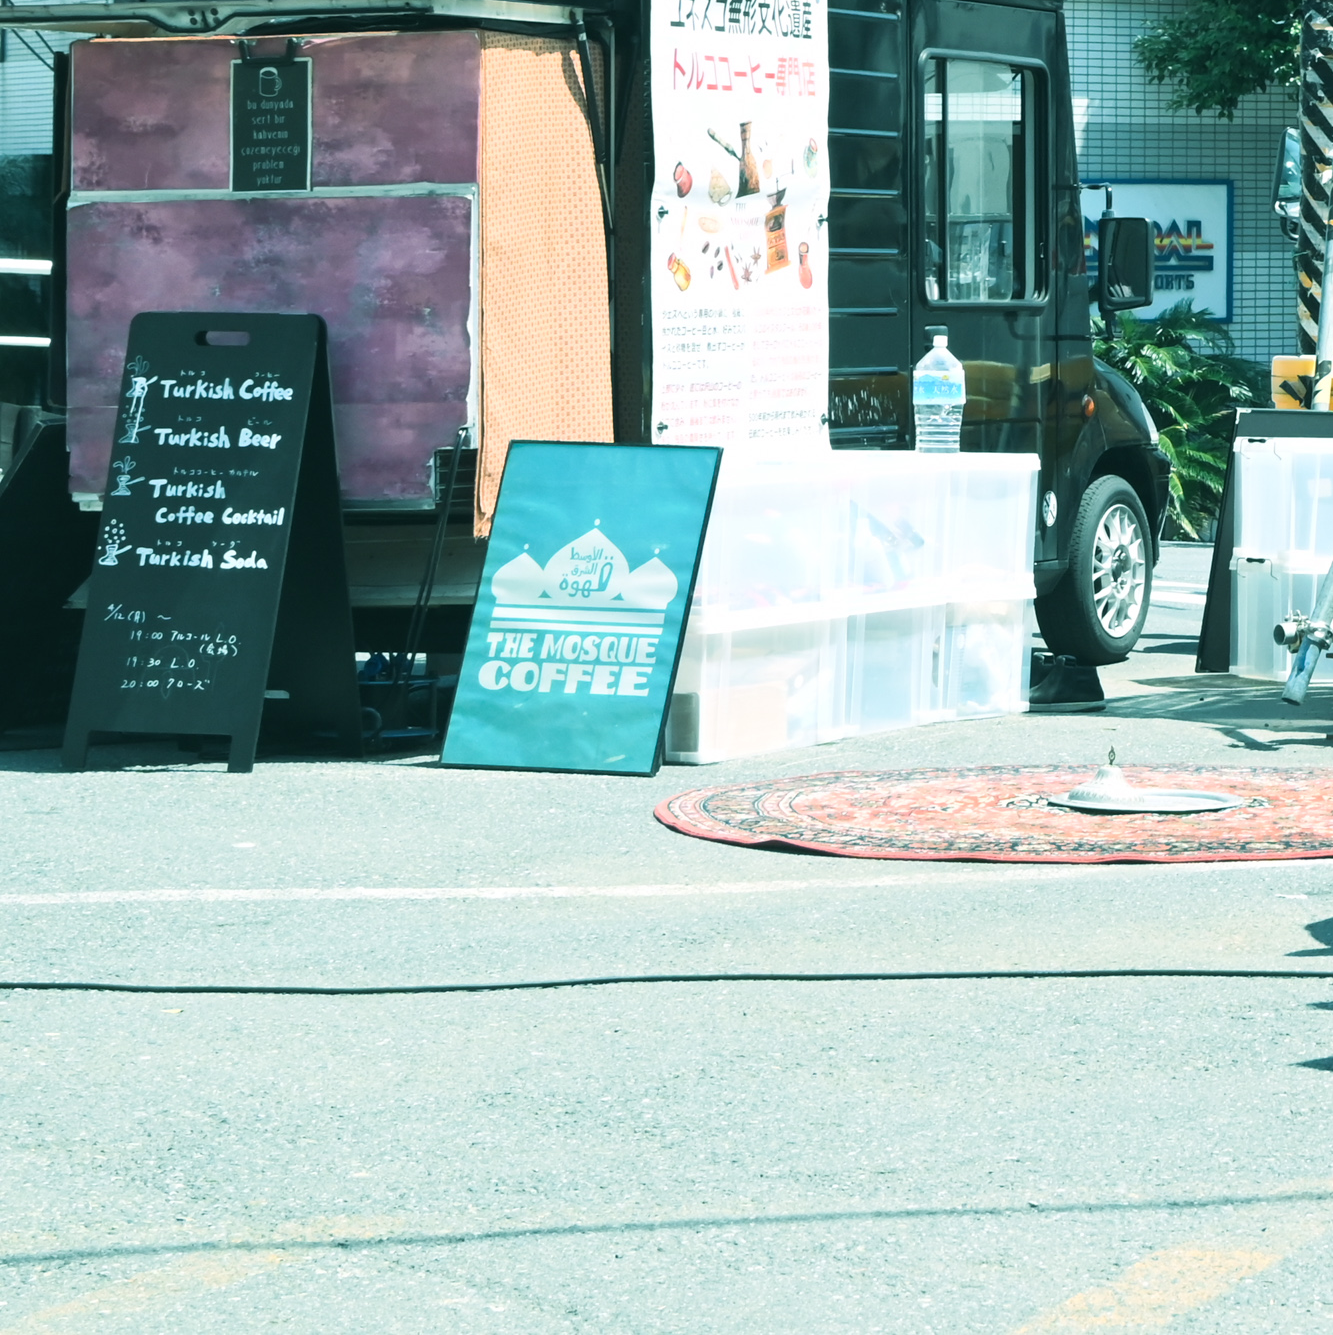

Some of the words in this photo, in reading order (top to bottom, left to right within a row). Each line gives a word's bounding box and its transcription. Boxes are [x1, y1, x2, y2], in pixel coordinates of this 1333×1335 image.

[673, 48, 816, 96] トルココーヒー専門店
[160, 377, 235, 400] Turkish
[239, 378, 294, 402] Coffee
[154, 426, 231, 449] Turkish
[238, 427, 282, 449] Beer
[149, 479, 226, 499] Turkish
[155, 506, 215, 525] Coffee
[221, 507, 285, 526] Cocktail
[136, 547, 214, 569] Turkish
[219, 549, 269, 569] Soda
[486, 632, 538, 659] THE
[540, 634, 659, 664] MOSQUE
[120, 679, 159, 689] 20:00
[478, 660, 653, 697] COFFEE
